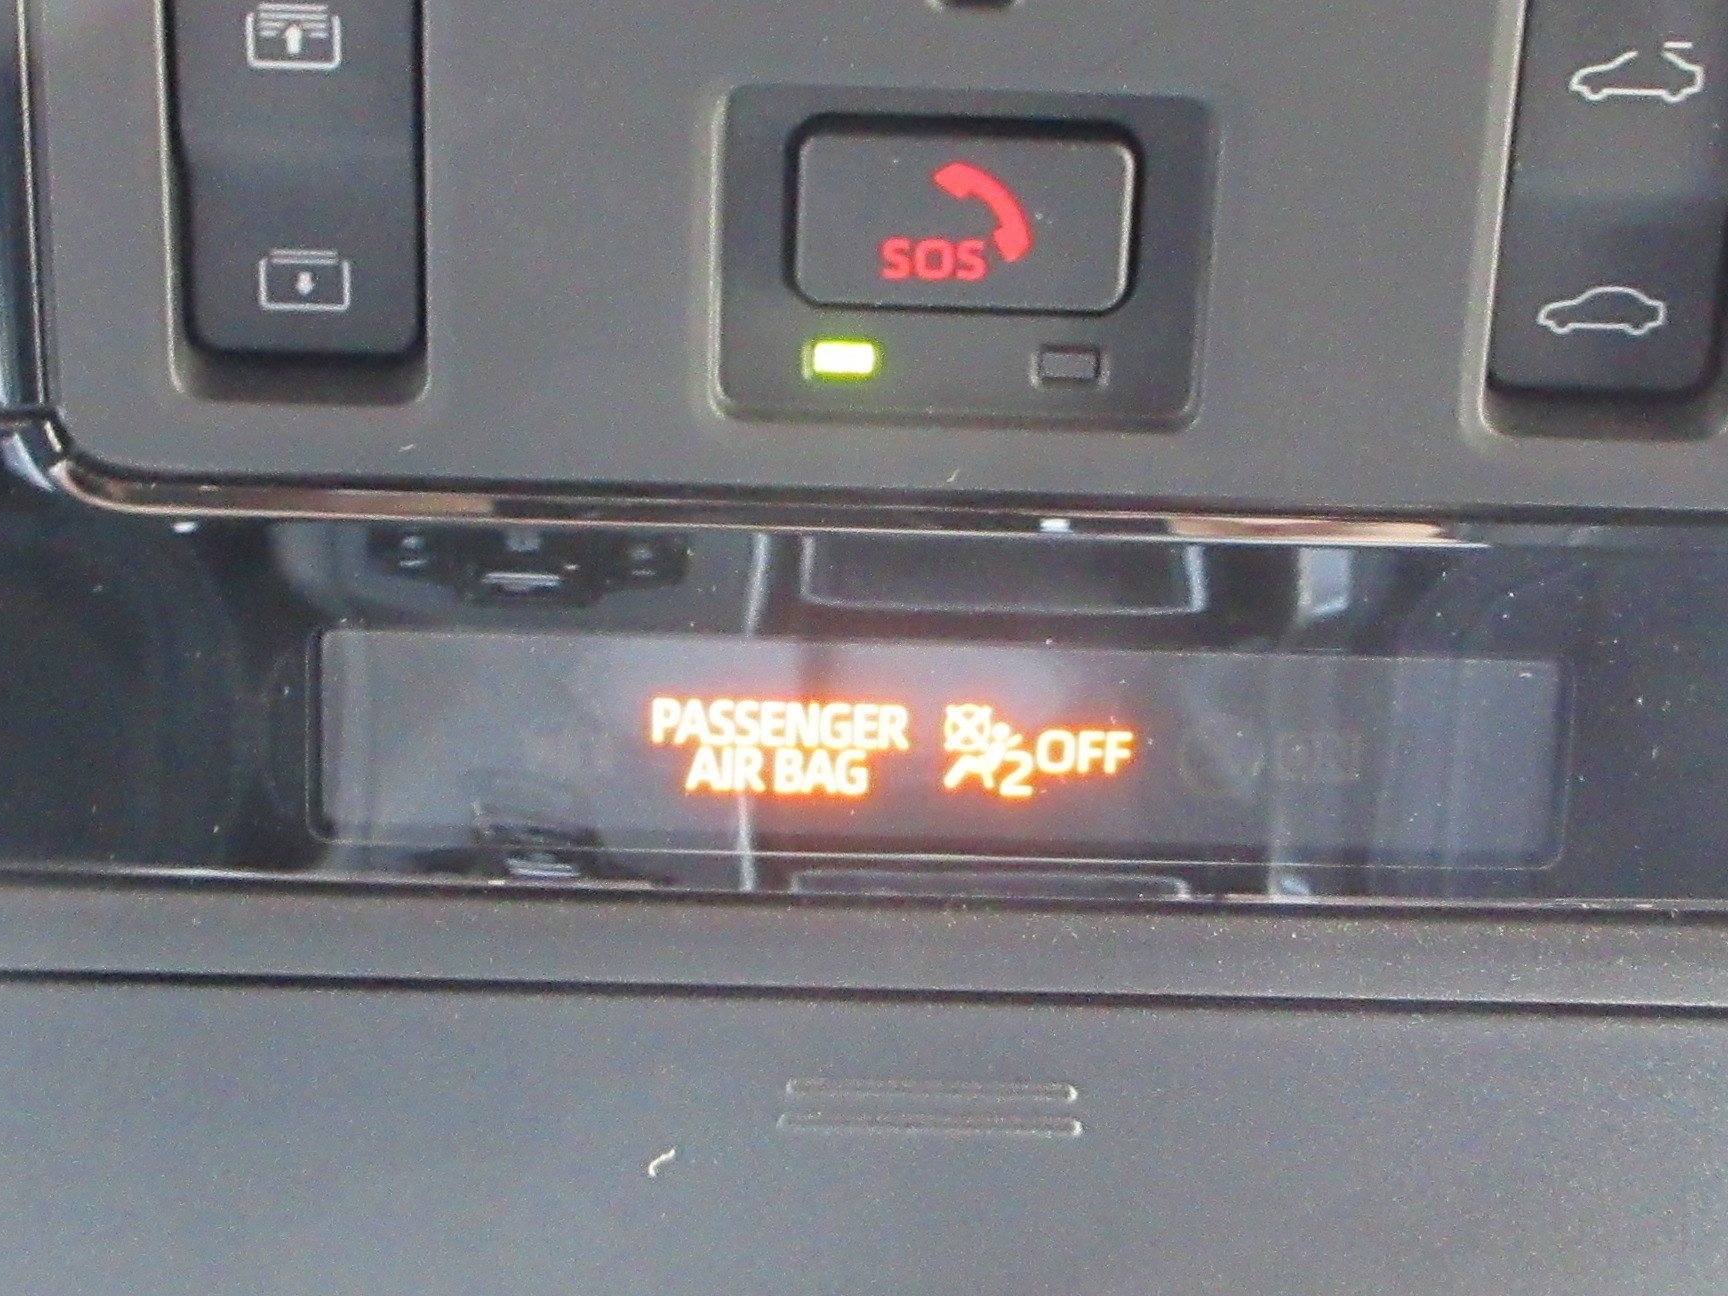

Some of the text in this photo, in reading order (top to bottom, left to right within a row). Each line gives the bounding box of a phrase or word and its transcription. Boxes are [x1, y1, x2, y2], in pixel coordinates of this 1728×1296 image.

[881, 237, 988, 281] SOS
[651, 697, 909, 750] PASSENGER
[684, 746, 869, 796] AIR BAG
[1035, 728, 1134, 774] OFF
